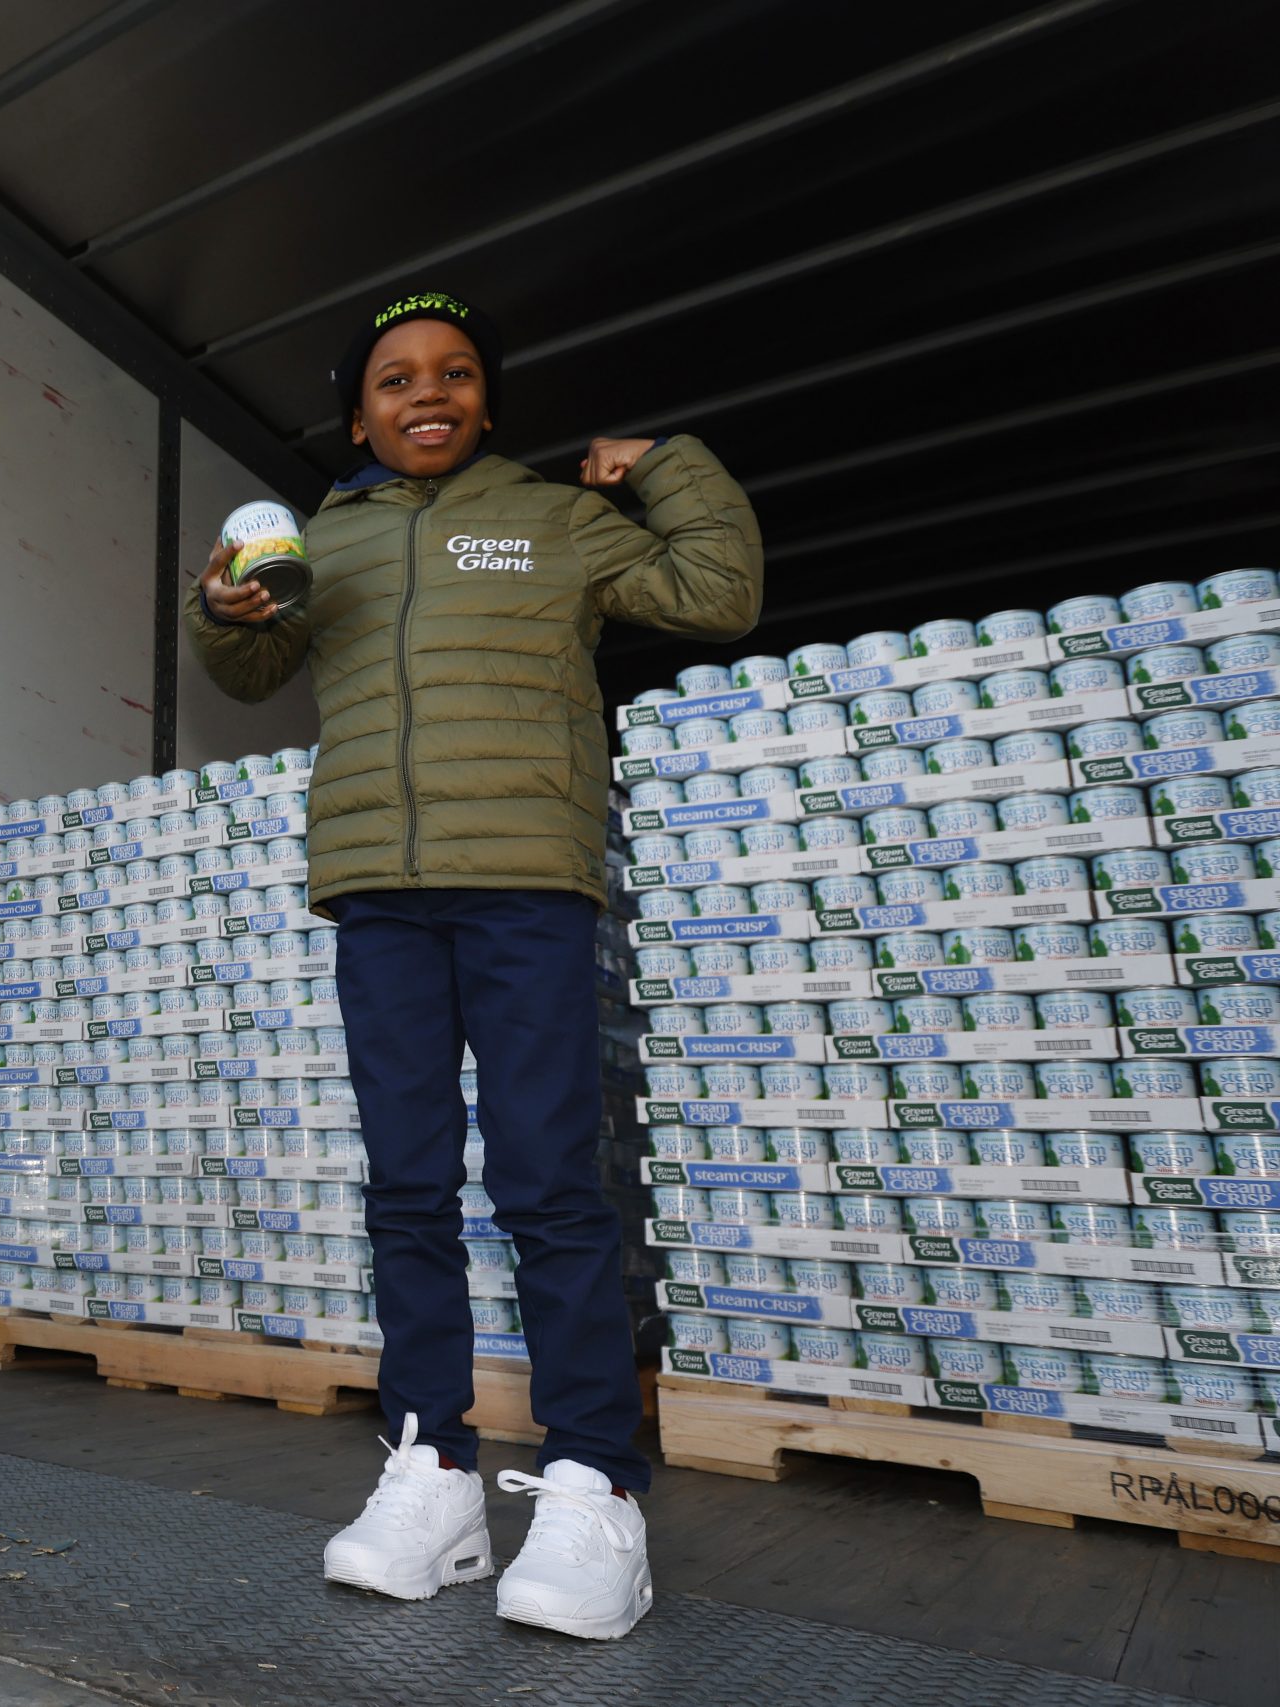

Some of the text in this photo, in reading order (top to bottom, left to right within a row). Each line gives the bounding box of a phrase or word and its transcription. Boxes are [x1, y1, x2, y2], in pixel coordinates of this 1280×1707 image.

[446, 535, 530, 553] Green
[456, 552, 534, 572] Giant
[1116, 623, 1170, 639] steam
[1199, 675, 1259, 691] steam
[667, 704, 708, 717] steam
[1140, 751, 1198, 766] steam
[671, 810, 713, 823] steam
[917, 841, 966, 854] steam
[872, 849, 903, 858] Green
[633, 870, 659, 878] Green
[671, 864, 711, 875] steam
[1112, 893, 1151, 903] Green
[1169, 886, 1229, 899] steam
[821, 913, 851, 921] Green
[866, 906, 914, 918] steam
[680, 925, 722, 935] steam
[883, 976, 915, 985] Green
[930, 971, 980, 983] steam
[640, 983, 667, 991] Green
[679, 978, 721, 989] steam
[1135, 1032, 1175, 1042] Green
[1194, 1030, 1257, 1041] steam
[691, 1043, 734, 1053] steam
[838, 1039, 870, 1048] Green
[885, 1037, 935, 1048] steam
[650, 1105, 676, 1113] Green
[689, 1104, 730, 1114] steam
[900, 1107, 933, 1116] Green
[949, 1105, 1000, 1115] steam
[1220, 1106, 1261, 1116] Green
[694, 1170, 739, 1180] steam
[842, 1169, 874, 1179] Green
[889, 1169, 939, 1181] steam
[1150, 1181, 1190, 1192] Green
[1210, 1182, 1273, 1196] steam
[657, 1223, 685, 1232] Green
[698, 1225, 741, 1237] steam
[915, 1239, 950, 1250] Green
[967, 1242, 1021, 1255] steam
[712, 1294, 758, 1308] steam
[862, 1309, 895, 1319] Green
[910, 1311, 962, 1325] steam
[1183, 1334, 1227, 1346] Green
[674, 1352, 703, 1362] Green
[716, 1356, 761, 1371] steam
[1180, 1374, 1234, 1389] steam
[941, 1384, 976, 1396] Green
[993, 1389, 1049, 1405] steam
